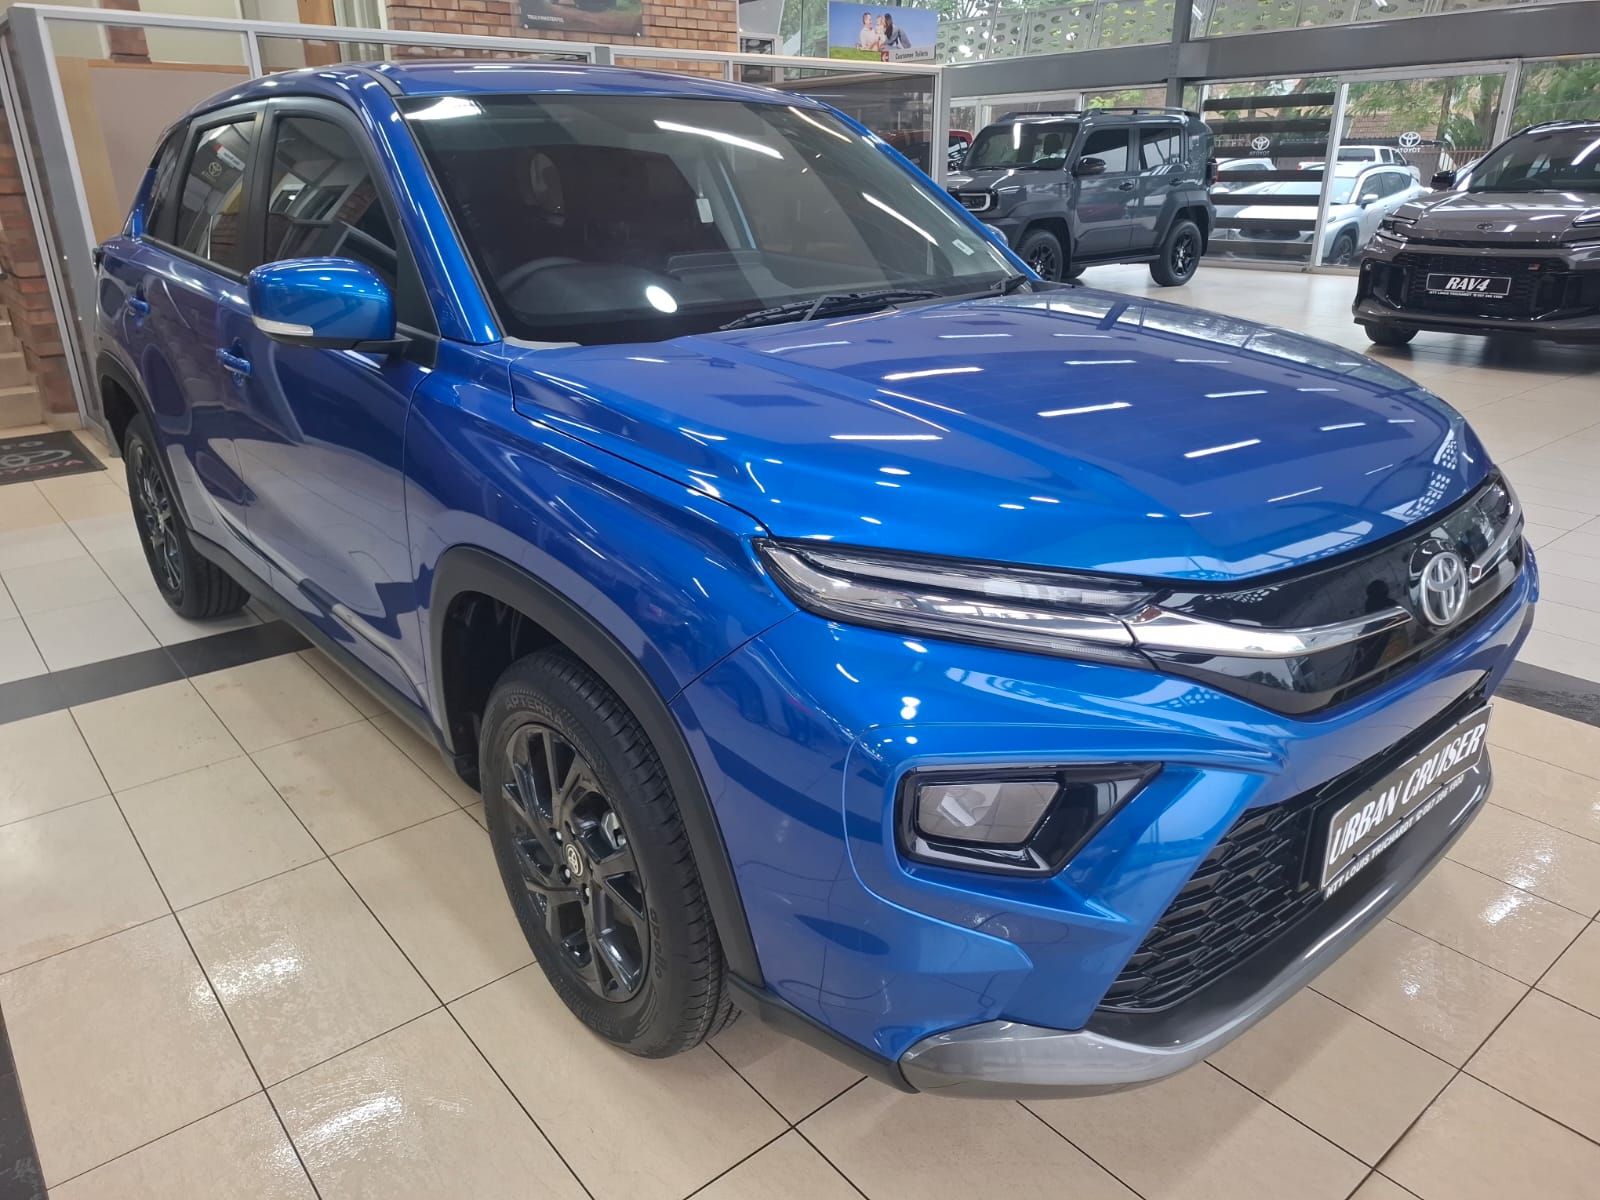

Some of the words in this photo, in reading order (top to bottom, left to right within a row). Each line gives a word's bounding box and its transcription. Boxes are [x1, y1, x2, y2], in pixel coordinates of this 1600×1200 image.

[1445, 277, 1491, 291] RAV4
[1328, 780, 1403, 865] URBAN
[1401, 722, 1487, 805] CRUISER
[1326, 875, 1345, 898] NTT
[1344, 853, 1370, 882] LOUIS
